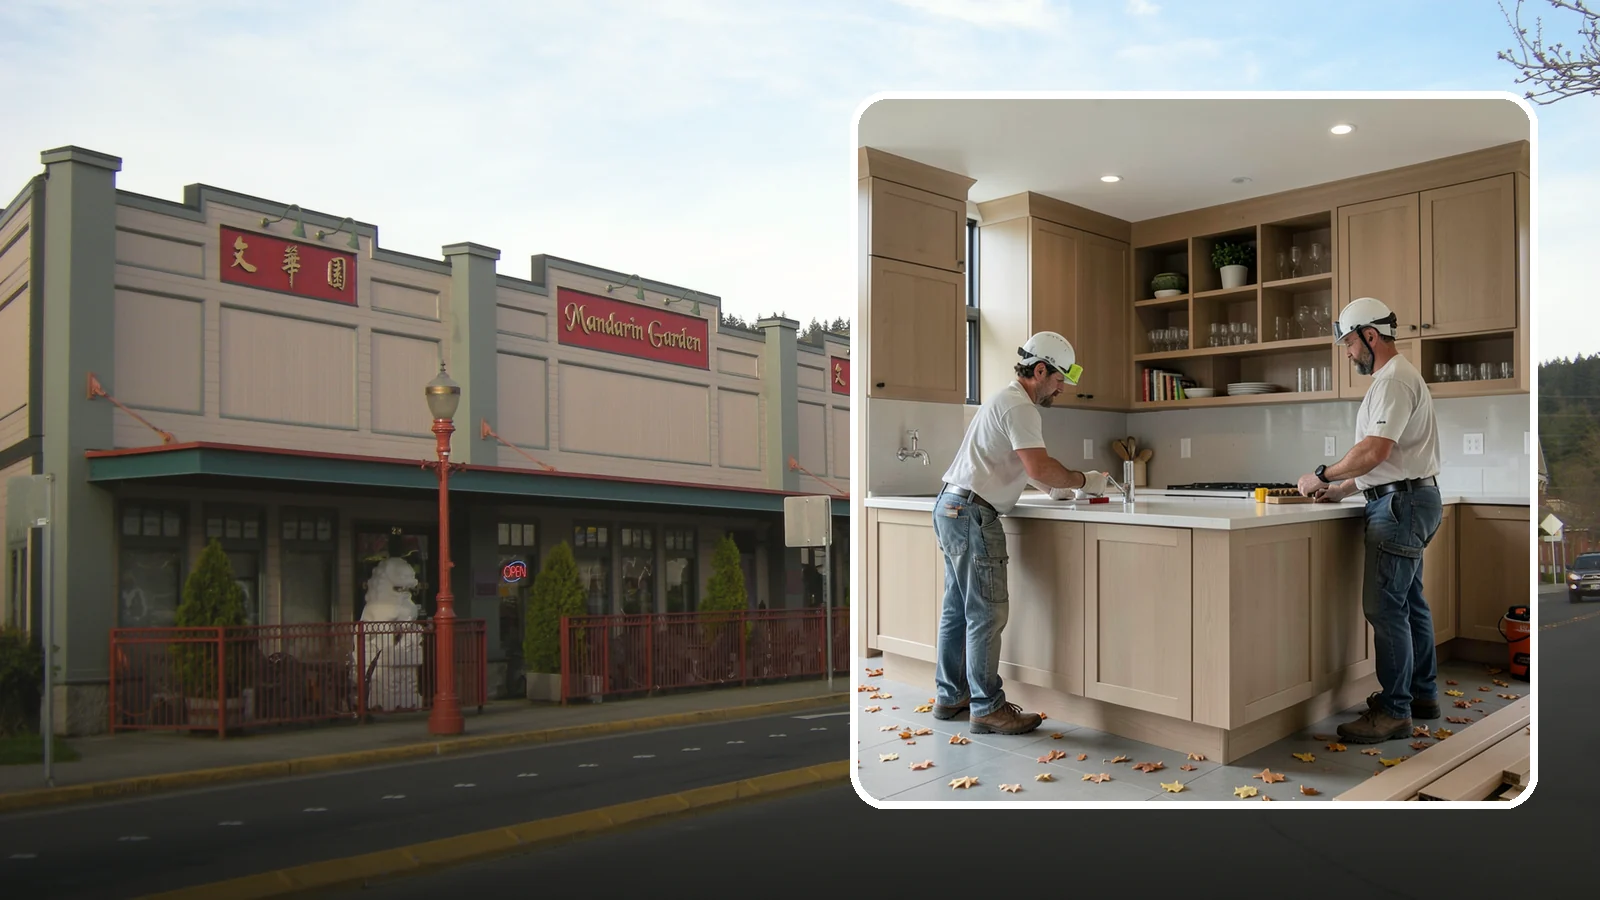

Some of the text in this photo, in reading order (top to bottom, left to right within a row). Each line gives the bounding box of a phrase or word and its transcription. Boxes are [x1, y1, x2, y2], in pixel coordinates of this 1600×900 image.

[564, 302, 702, 352] Mandarin Garden
[503, 565, 527, 578] OPEN
